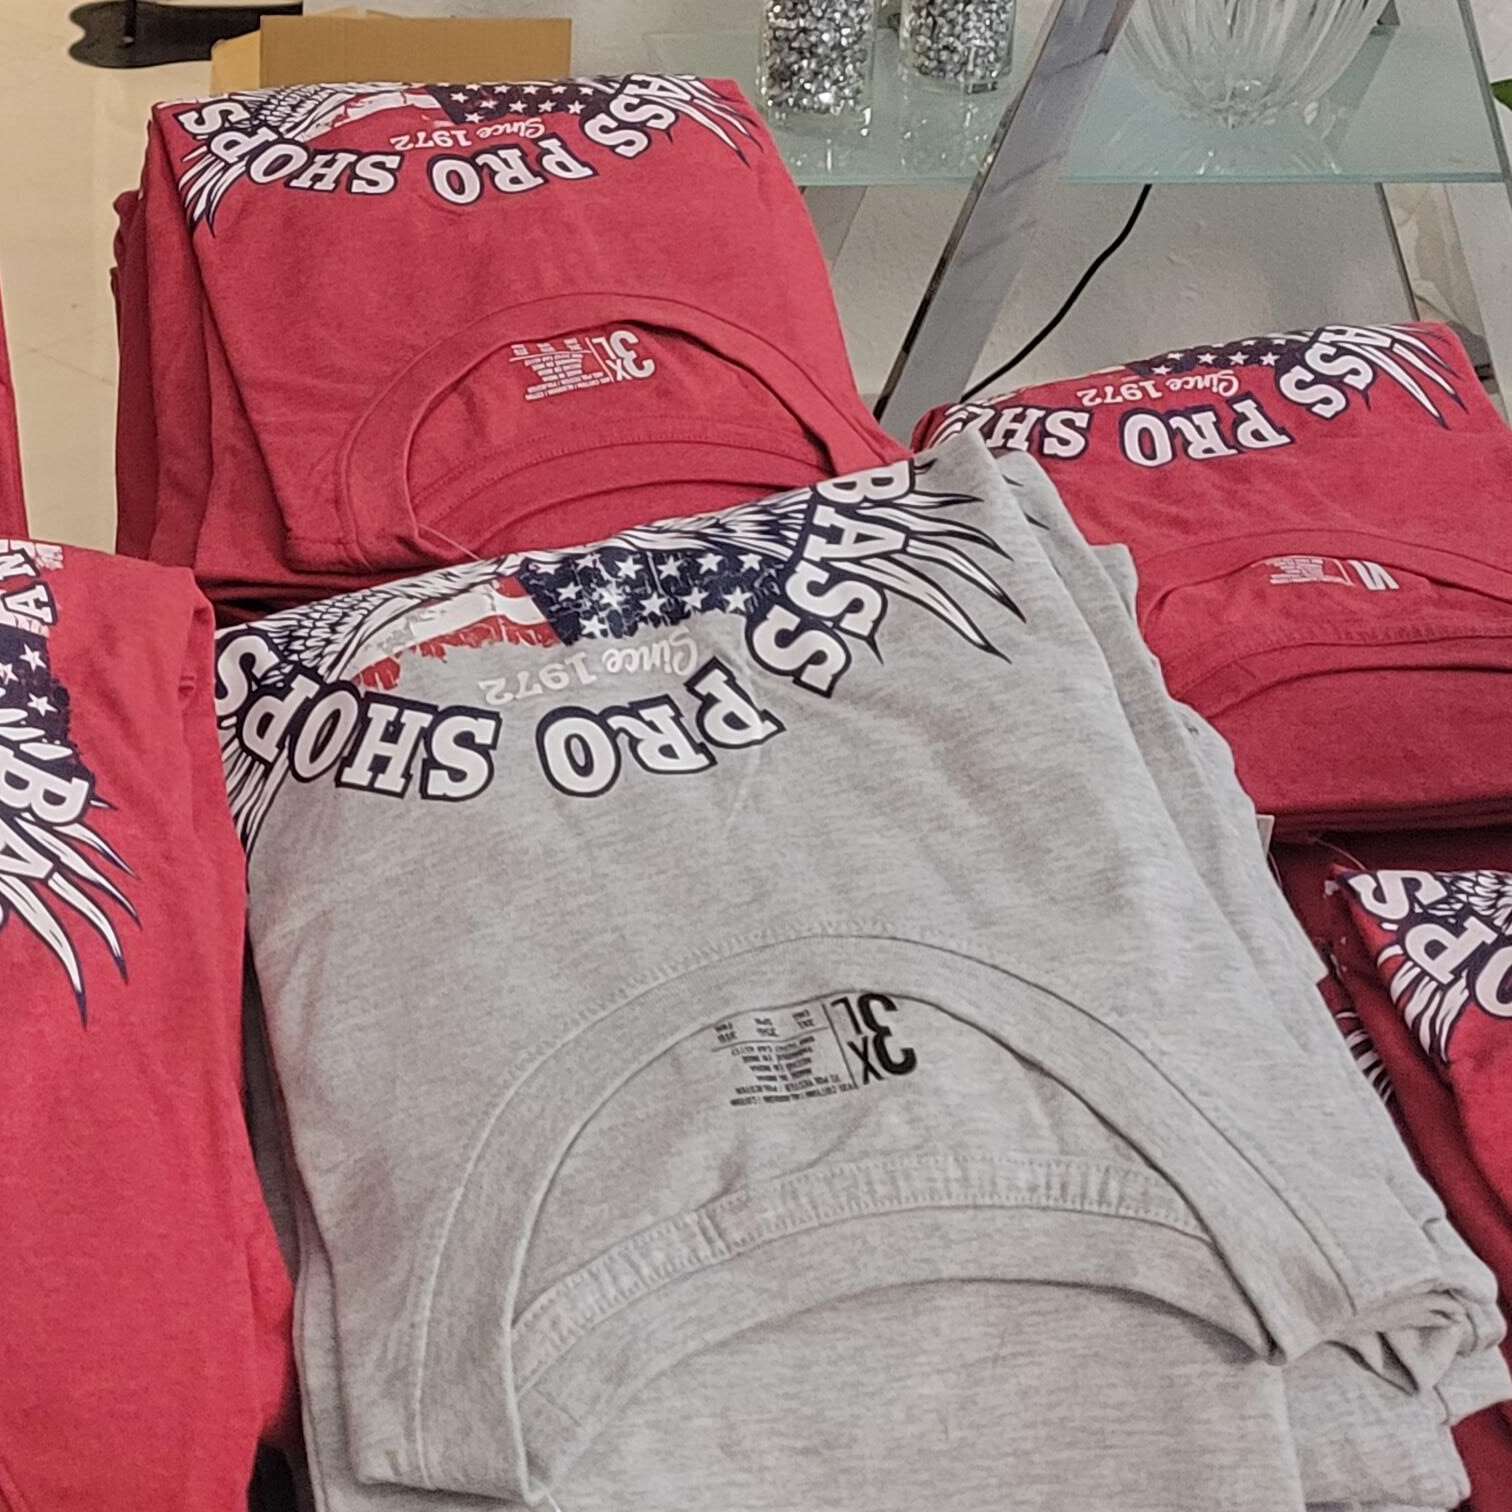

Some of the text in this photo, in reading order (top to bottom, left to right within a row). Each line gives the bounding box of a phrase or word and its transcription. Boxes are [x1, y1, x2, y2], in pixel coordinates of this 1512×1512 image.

[177, 72, 694, 206] ASS PRO SHOPS
[390, 116, 545, 151] Since 1972
[1076, 368, 1240, 407] Since 1972
[1276, 325, 1394, 421] ASS
[1119, 391, 1294, 468] PRO
[214, 458, 916, 802] BASS PRO SHOPS
[478, 624, 698, 708] Since 1972
